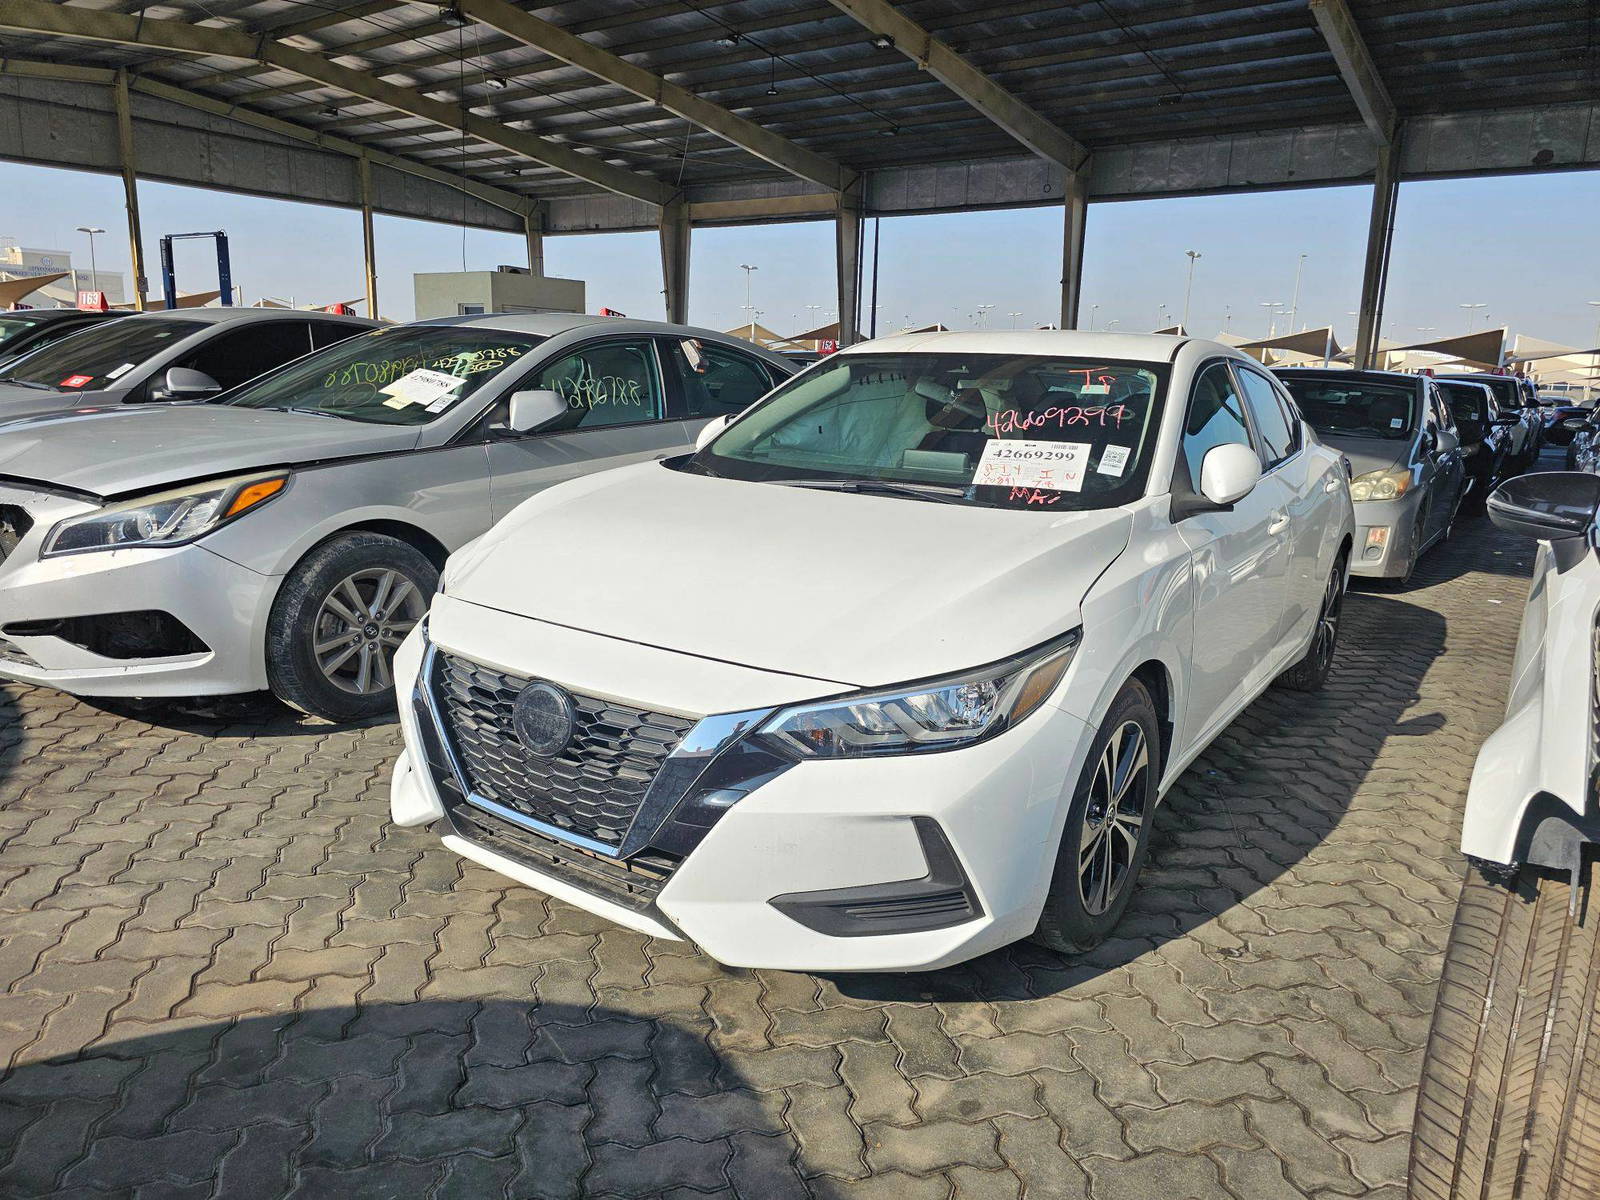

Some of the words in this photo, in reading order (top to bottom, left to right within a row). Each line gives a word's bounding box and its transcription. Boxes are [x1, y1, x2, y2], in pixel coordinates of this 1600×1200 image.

[81, 292, 99, 305] 163
[987, 404, 1125, 439] 42669299
[993, 448, 1075, 461] 42669299
